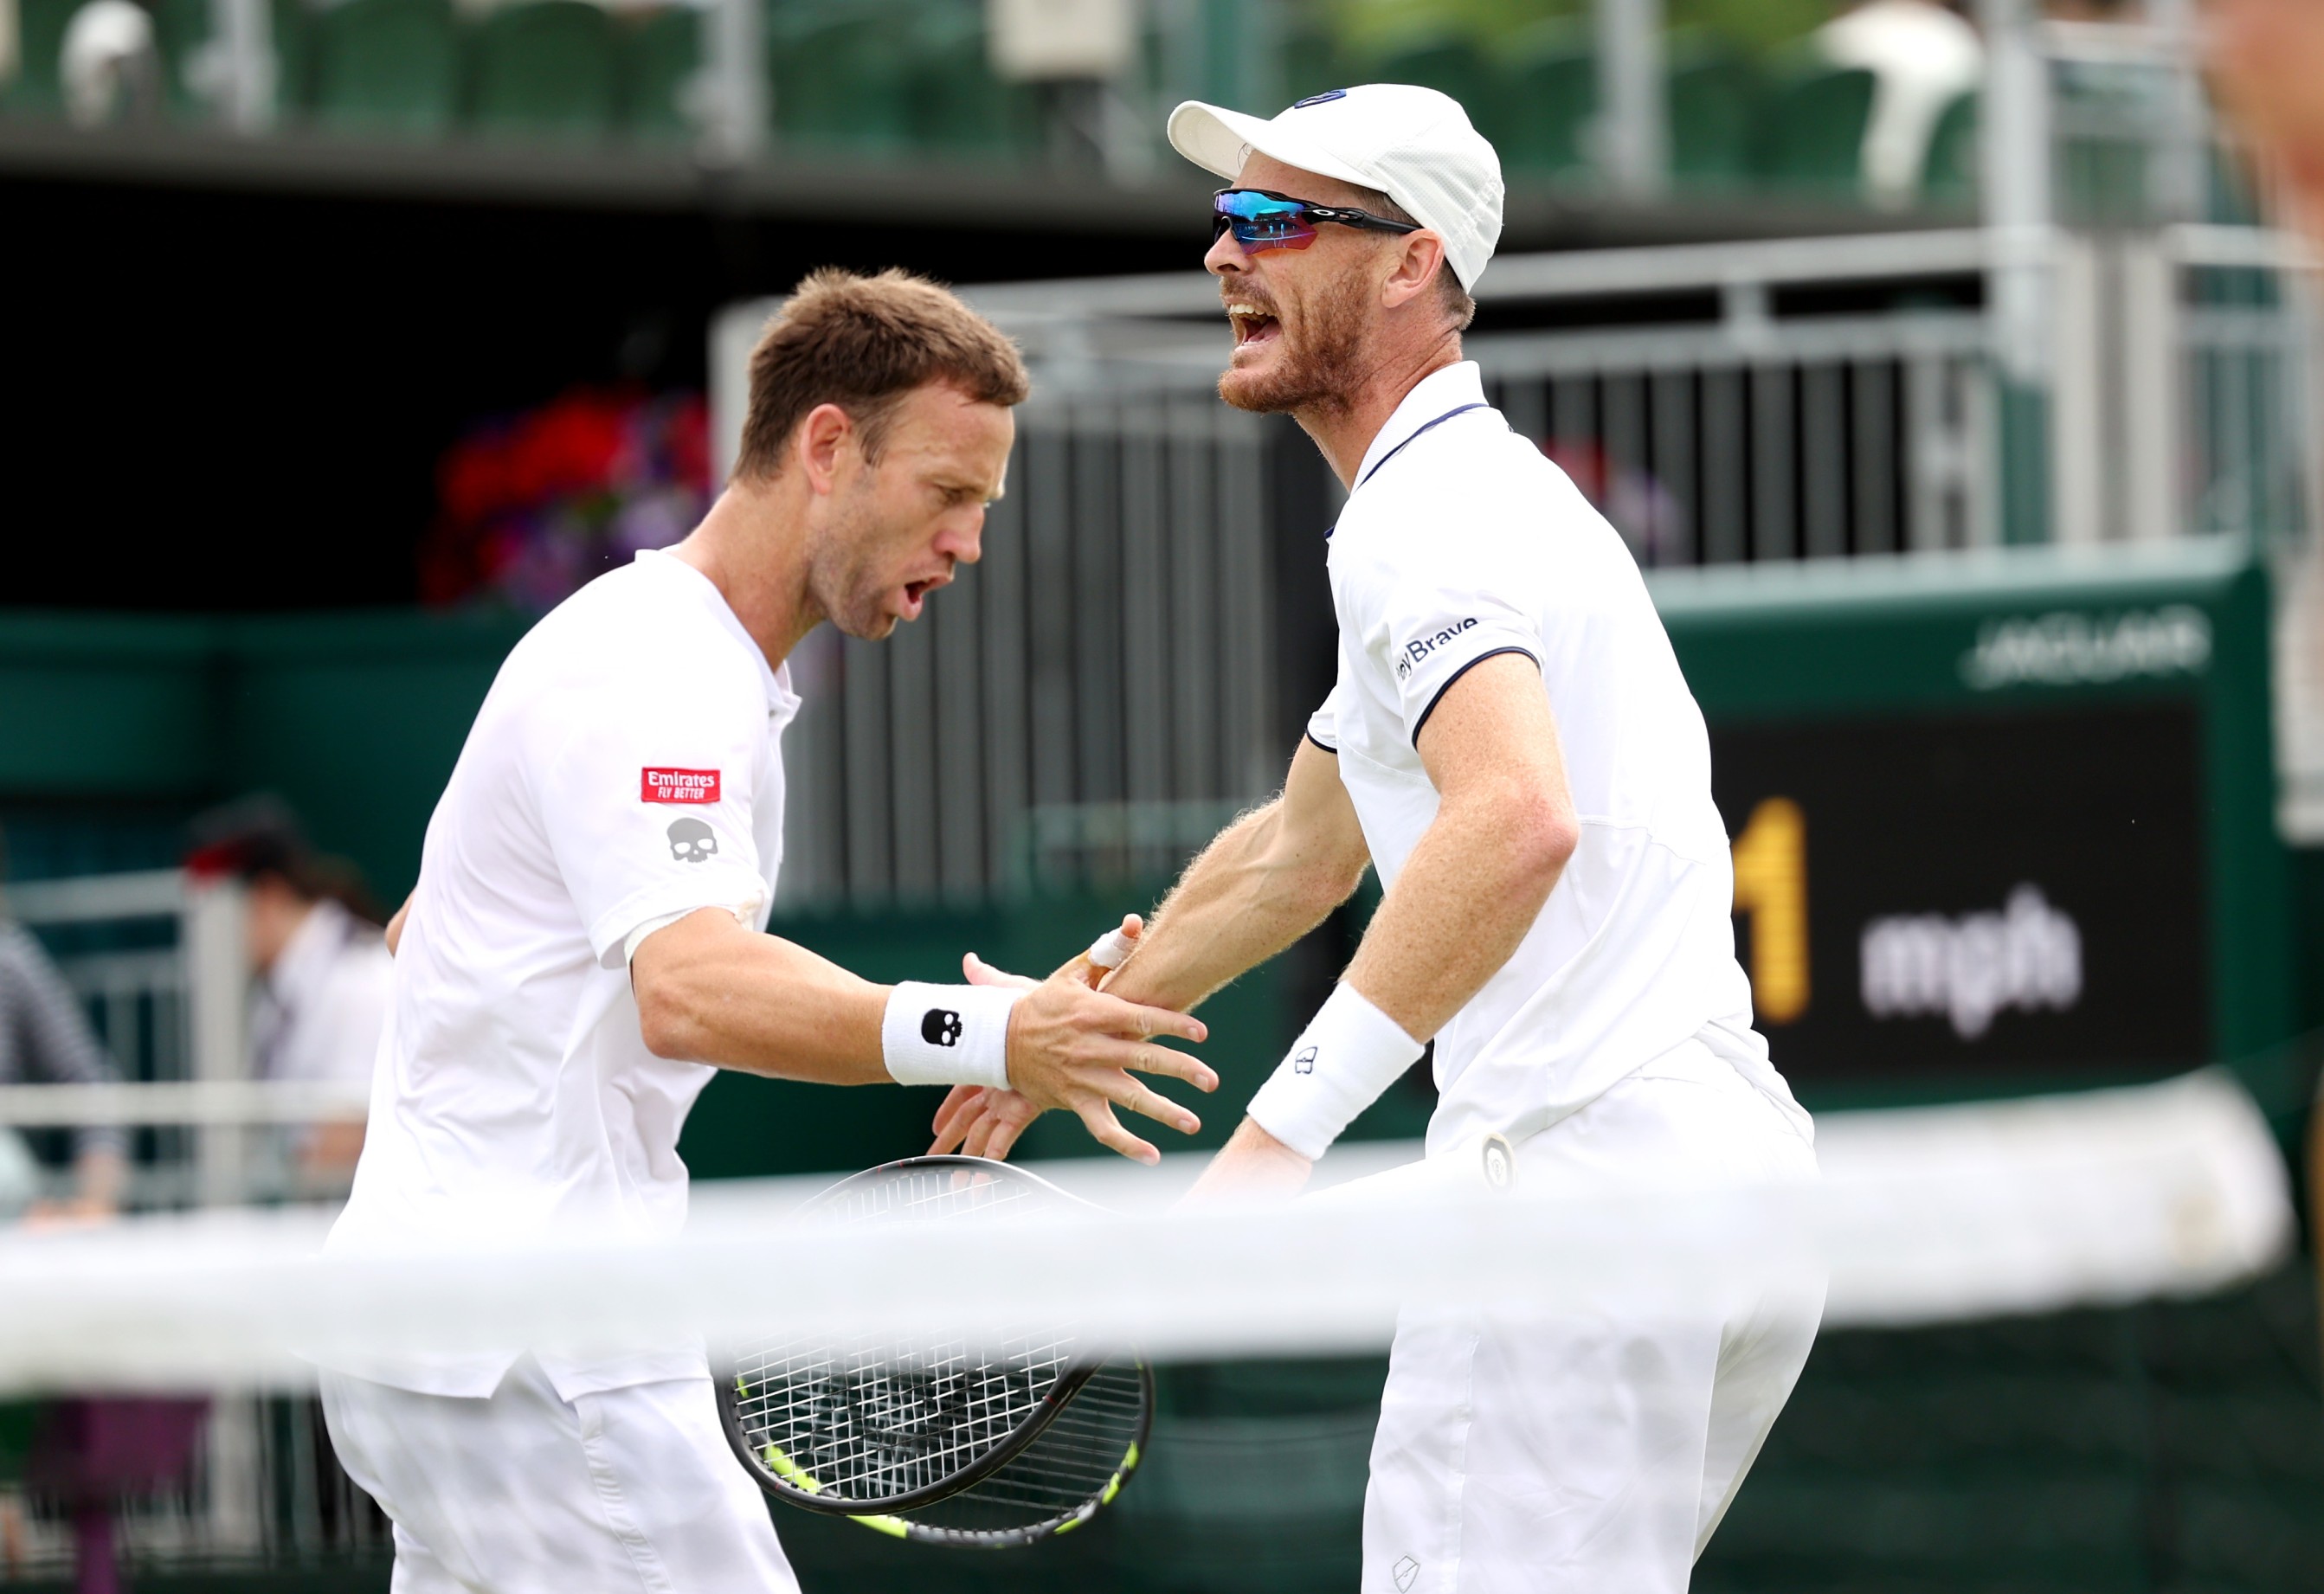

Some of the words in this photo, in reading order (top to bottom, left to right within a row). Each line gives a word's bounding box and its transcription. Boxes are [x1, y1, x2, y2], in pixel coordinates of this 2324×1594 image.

[647, 771, 715, 787] Emirates
[658, 787, 673, 799] FLY
[674, 787, 705, 800] BETTER
[1860, 884, 2083, 1038] mph
